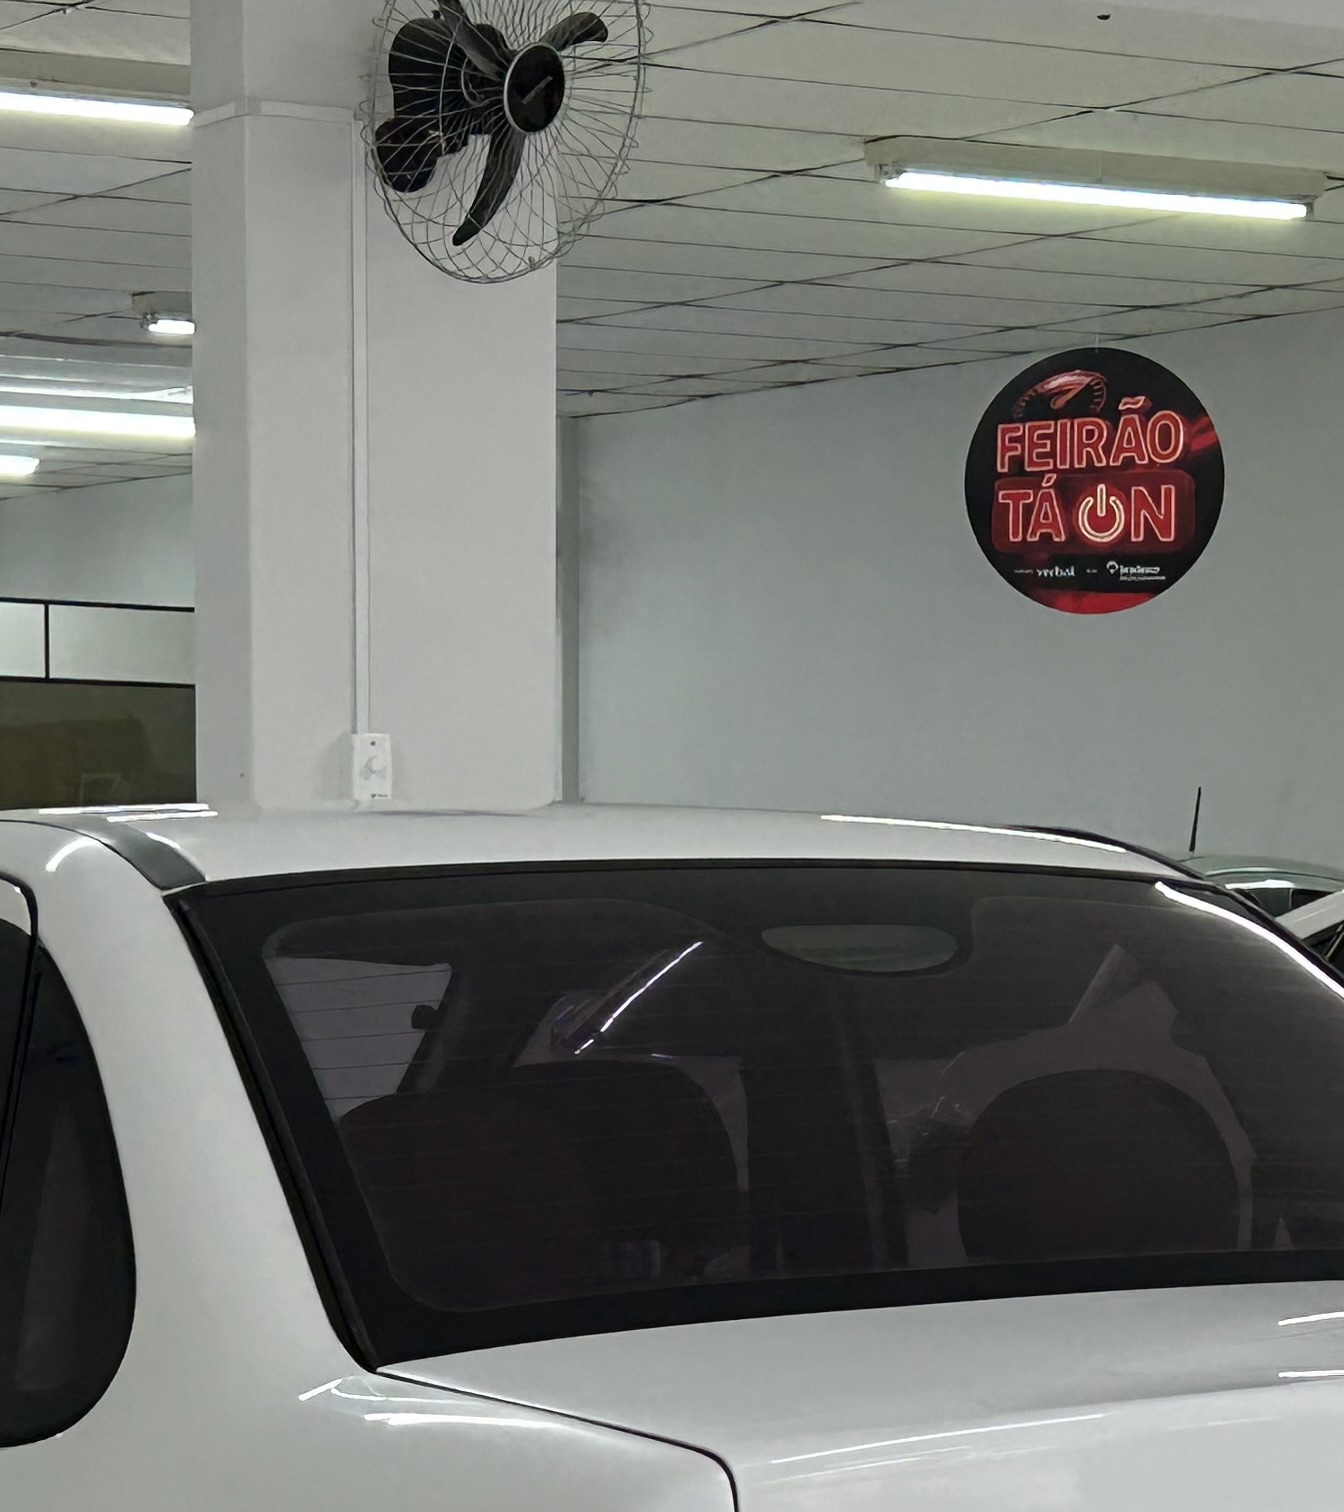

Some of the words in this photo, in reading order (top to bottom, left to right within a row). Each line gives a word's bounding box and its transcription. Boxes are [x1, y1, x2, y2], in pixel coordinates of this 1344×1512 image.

[996, 395, 1185, 473] FEIRÃO
[998, 473, 1066, 542] TÁ
[1078, 483, 1176, 543] ON
